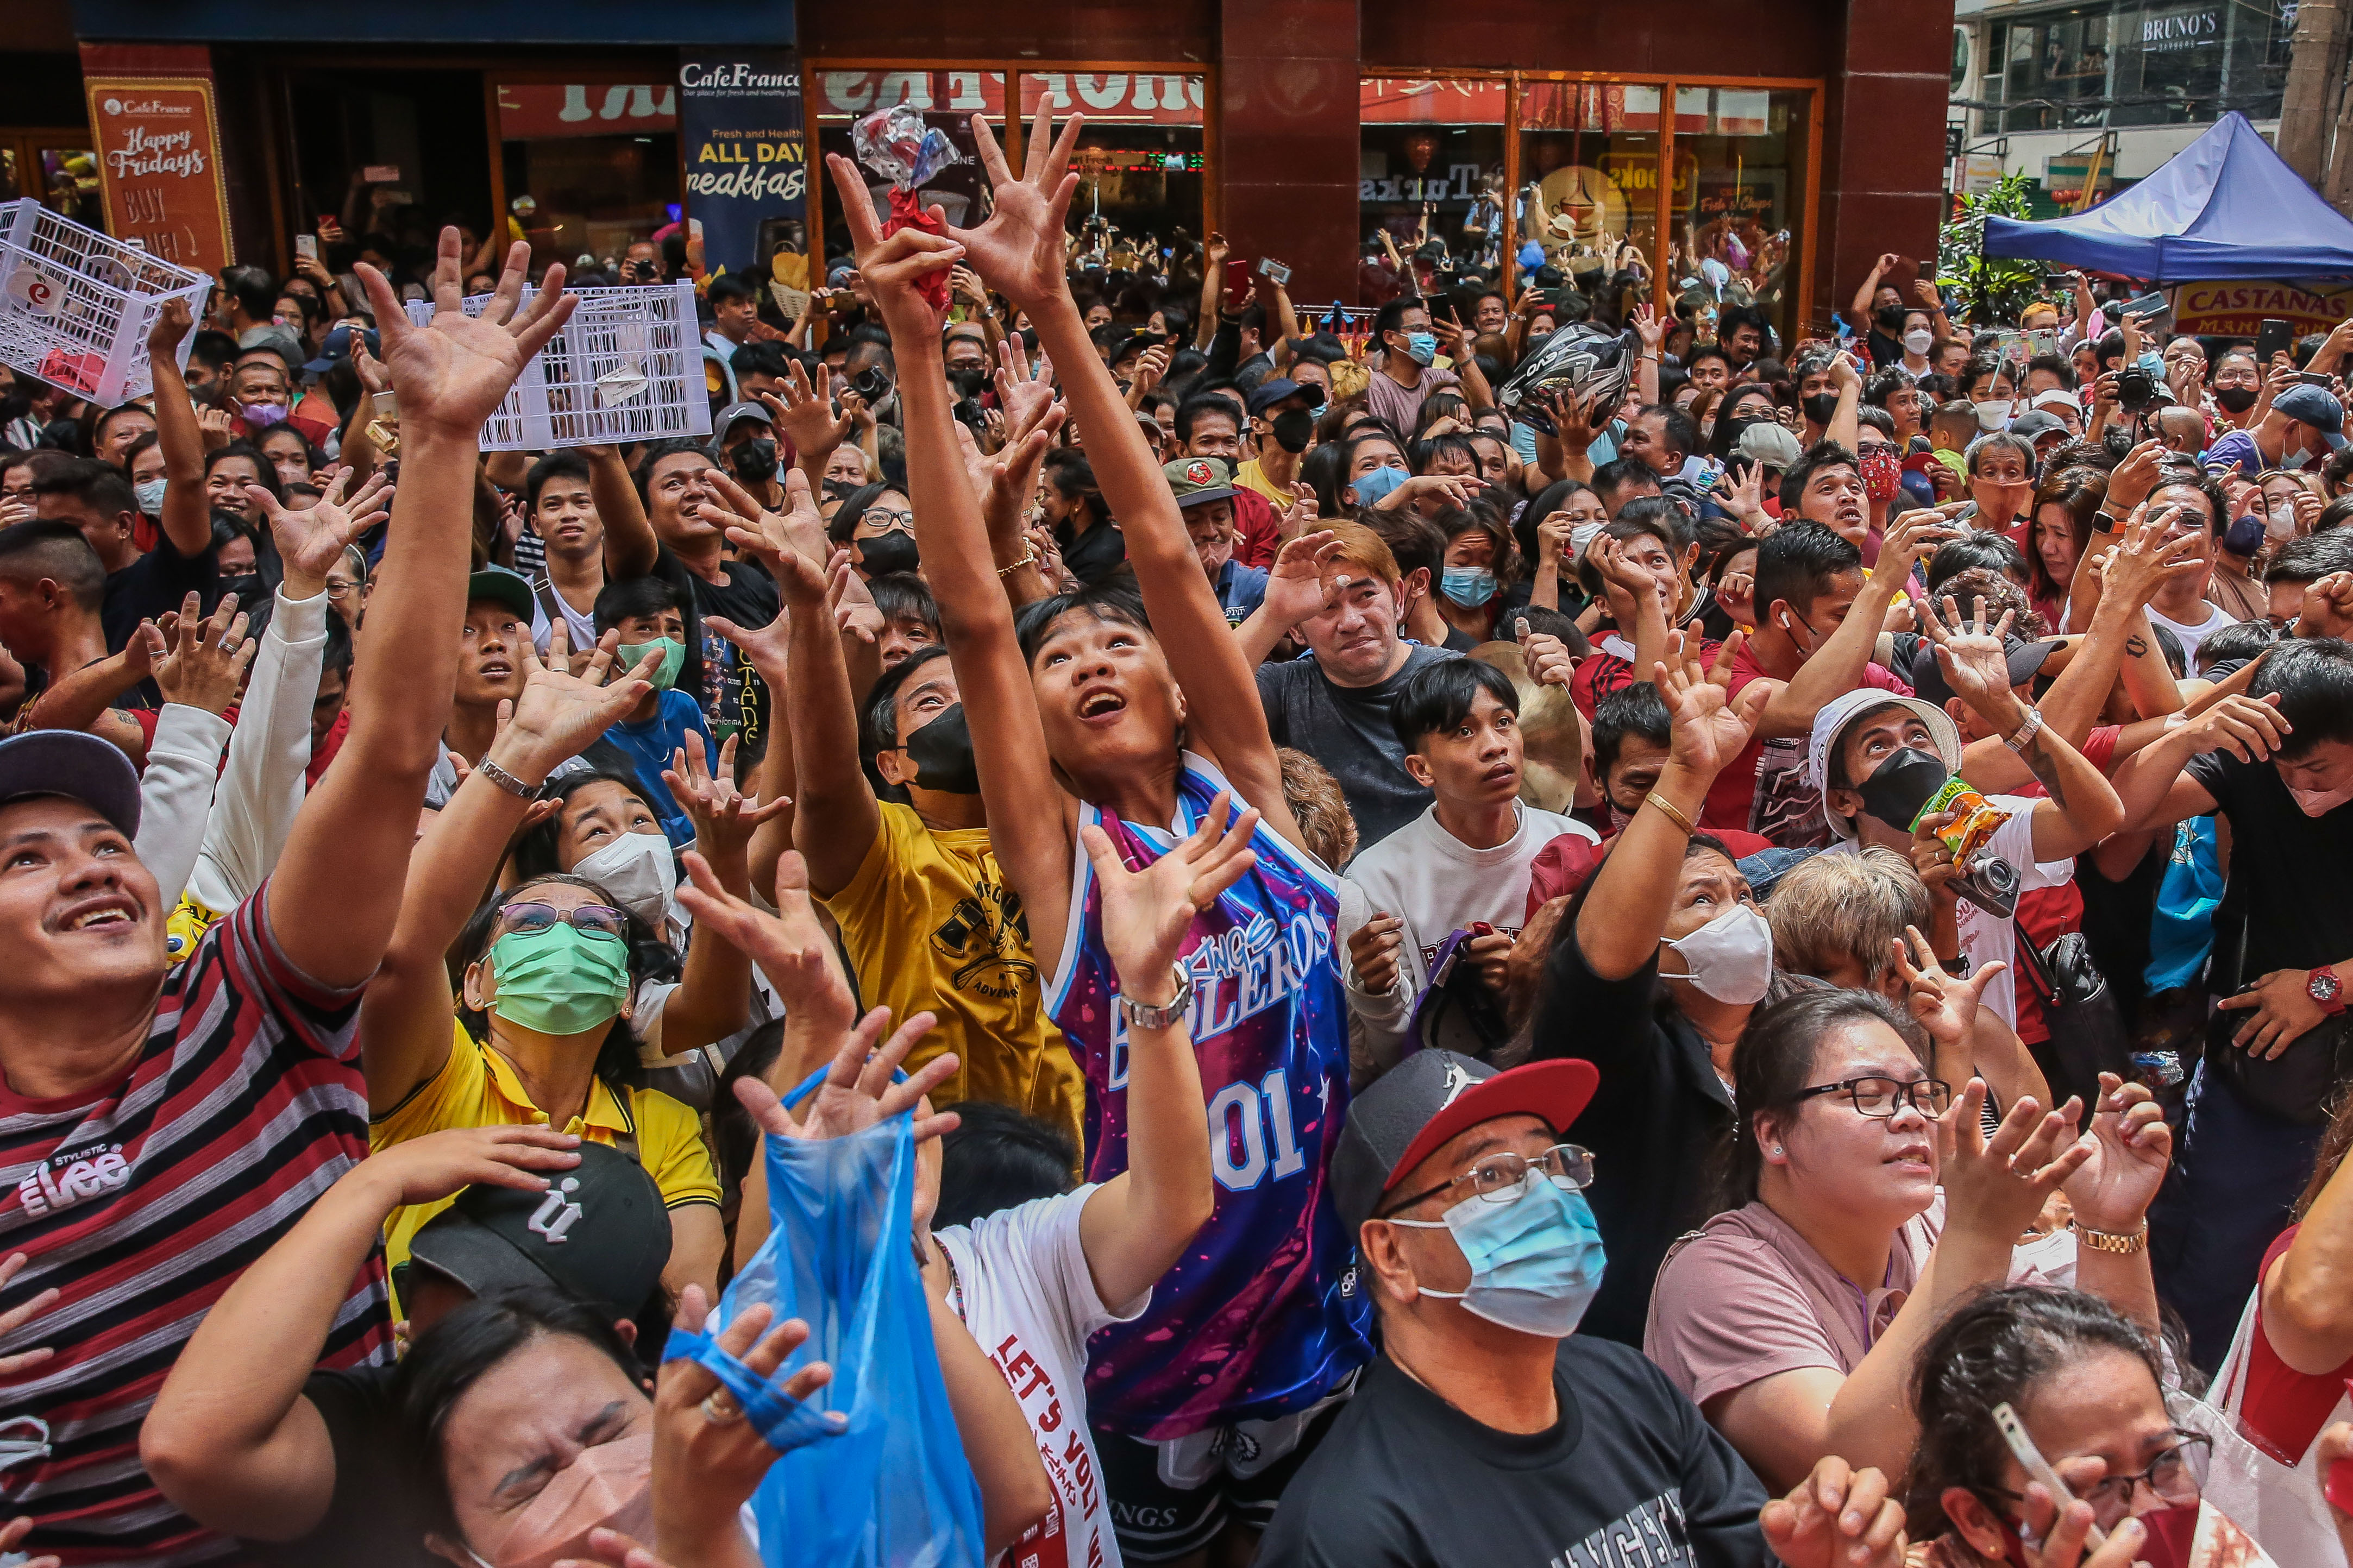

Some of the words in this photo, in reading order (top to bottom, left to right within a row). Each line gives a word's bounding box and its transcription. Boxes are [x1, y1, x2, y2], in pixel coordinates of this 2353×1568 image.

[2143, 12, 2216, 42] BRUNO'S
[122, 125, 191, 153] Happy
[712, 129, 742, 138] Fresh
[745, 129, 765, 138] and
[768, 129, 802, 138] Health
[107, 149, 207, 179] Fridays
[699, 143, 750, 163] ALL
[757, 143, 804, 163] DAY
[686, 161, 807, 200] reakfast
[2187, 288, 2346, 319] CASTANAS
[2197, 319, 2327, 335] MANRIN
[1526, 351, 1559, 377] EVO
[1942, 782, 1974, 799] Chips
[55, 1143, 108, 1166] STYLISTIC
[997, 1333, 1063, 1433] LET'S
